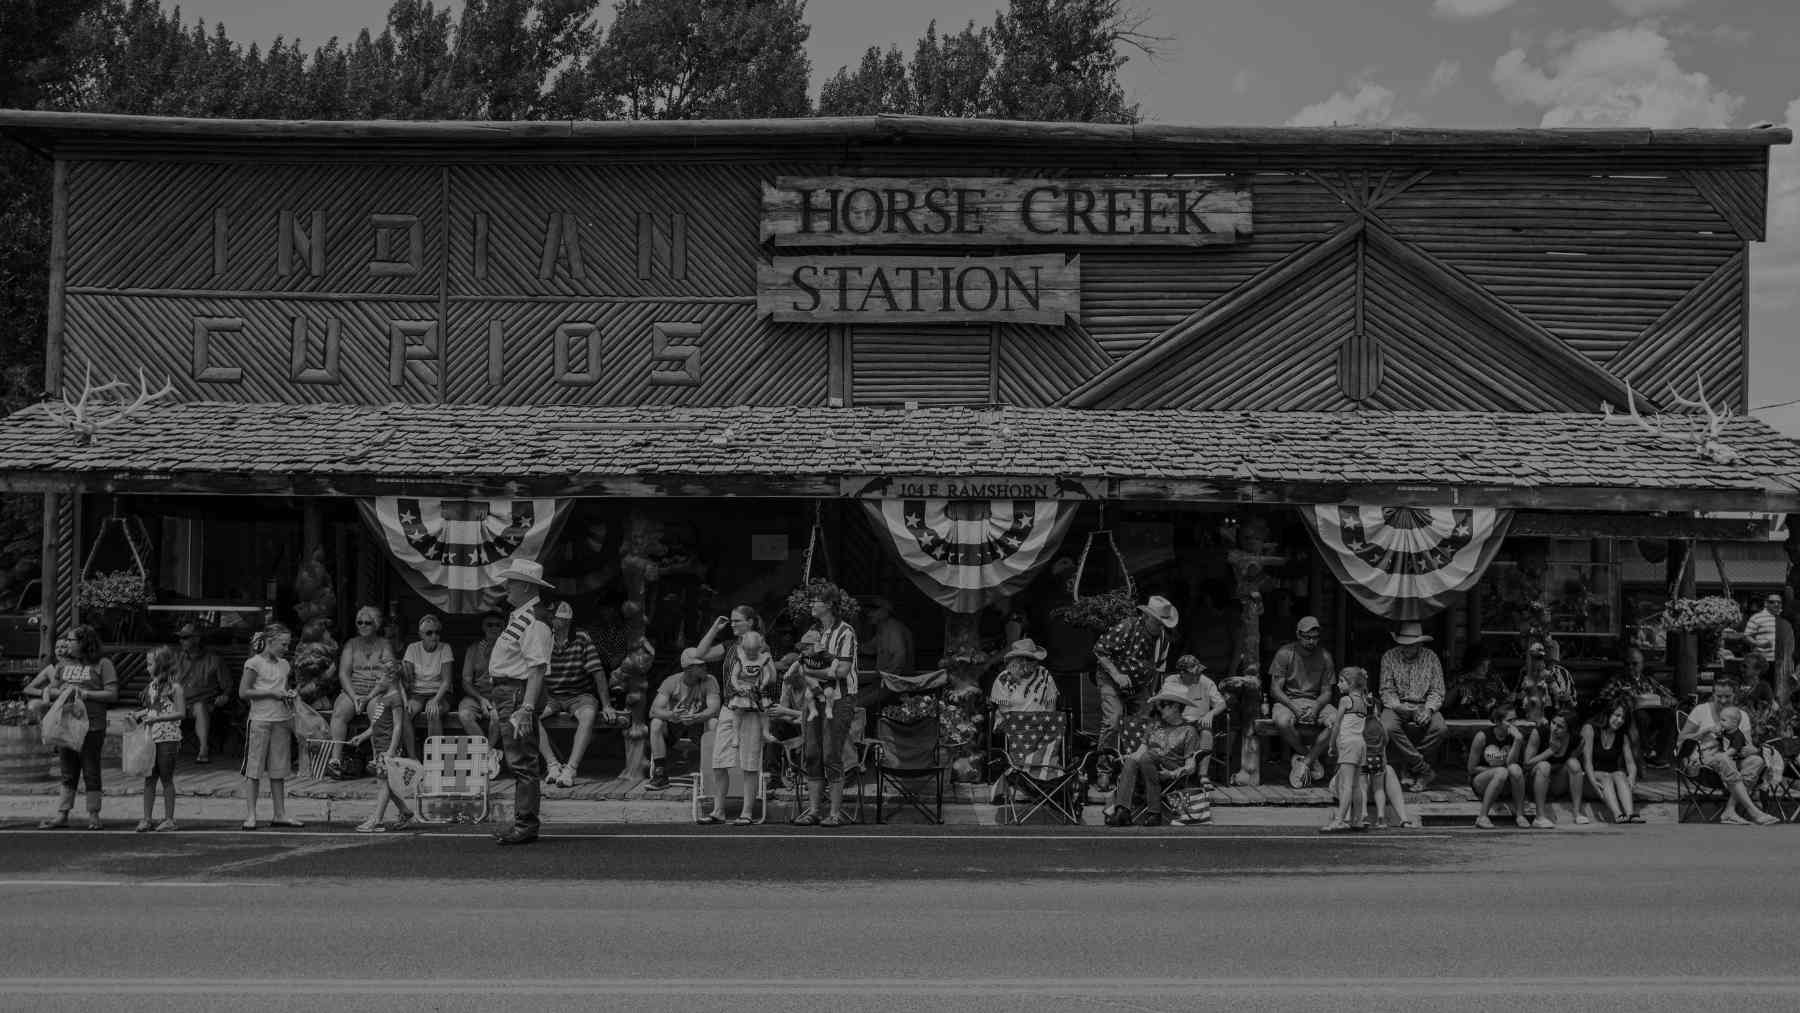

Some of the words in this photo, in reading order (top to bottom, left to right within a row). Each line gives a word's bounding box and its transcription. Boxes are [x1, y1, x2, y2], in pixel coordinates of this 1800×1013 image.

[800, 188, 985, 234] HORSE
[1021, 187, 1211, 234] CREEK
[213, 207, 688, 280] INDIAN
[792, 265, 1043, 313] STATION
[193, 316, 700, 386] CURIOS
[901, 483, 923, 497] 104
[948, 483, 1048, 497] RAMSHORN
[63, 665, 91, 680] USA
